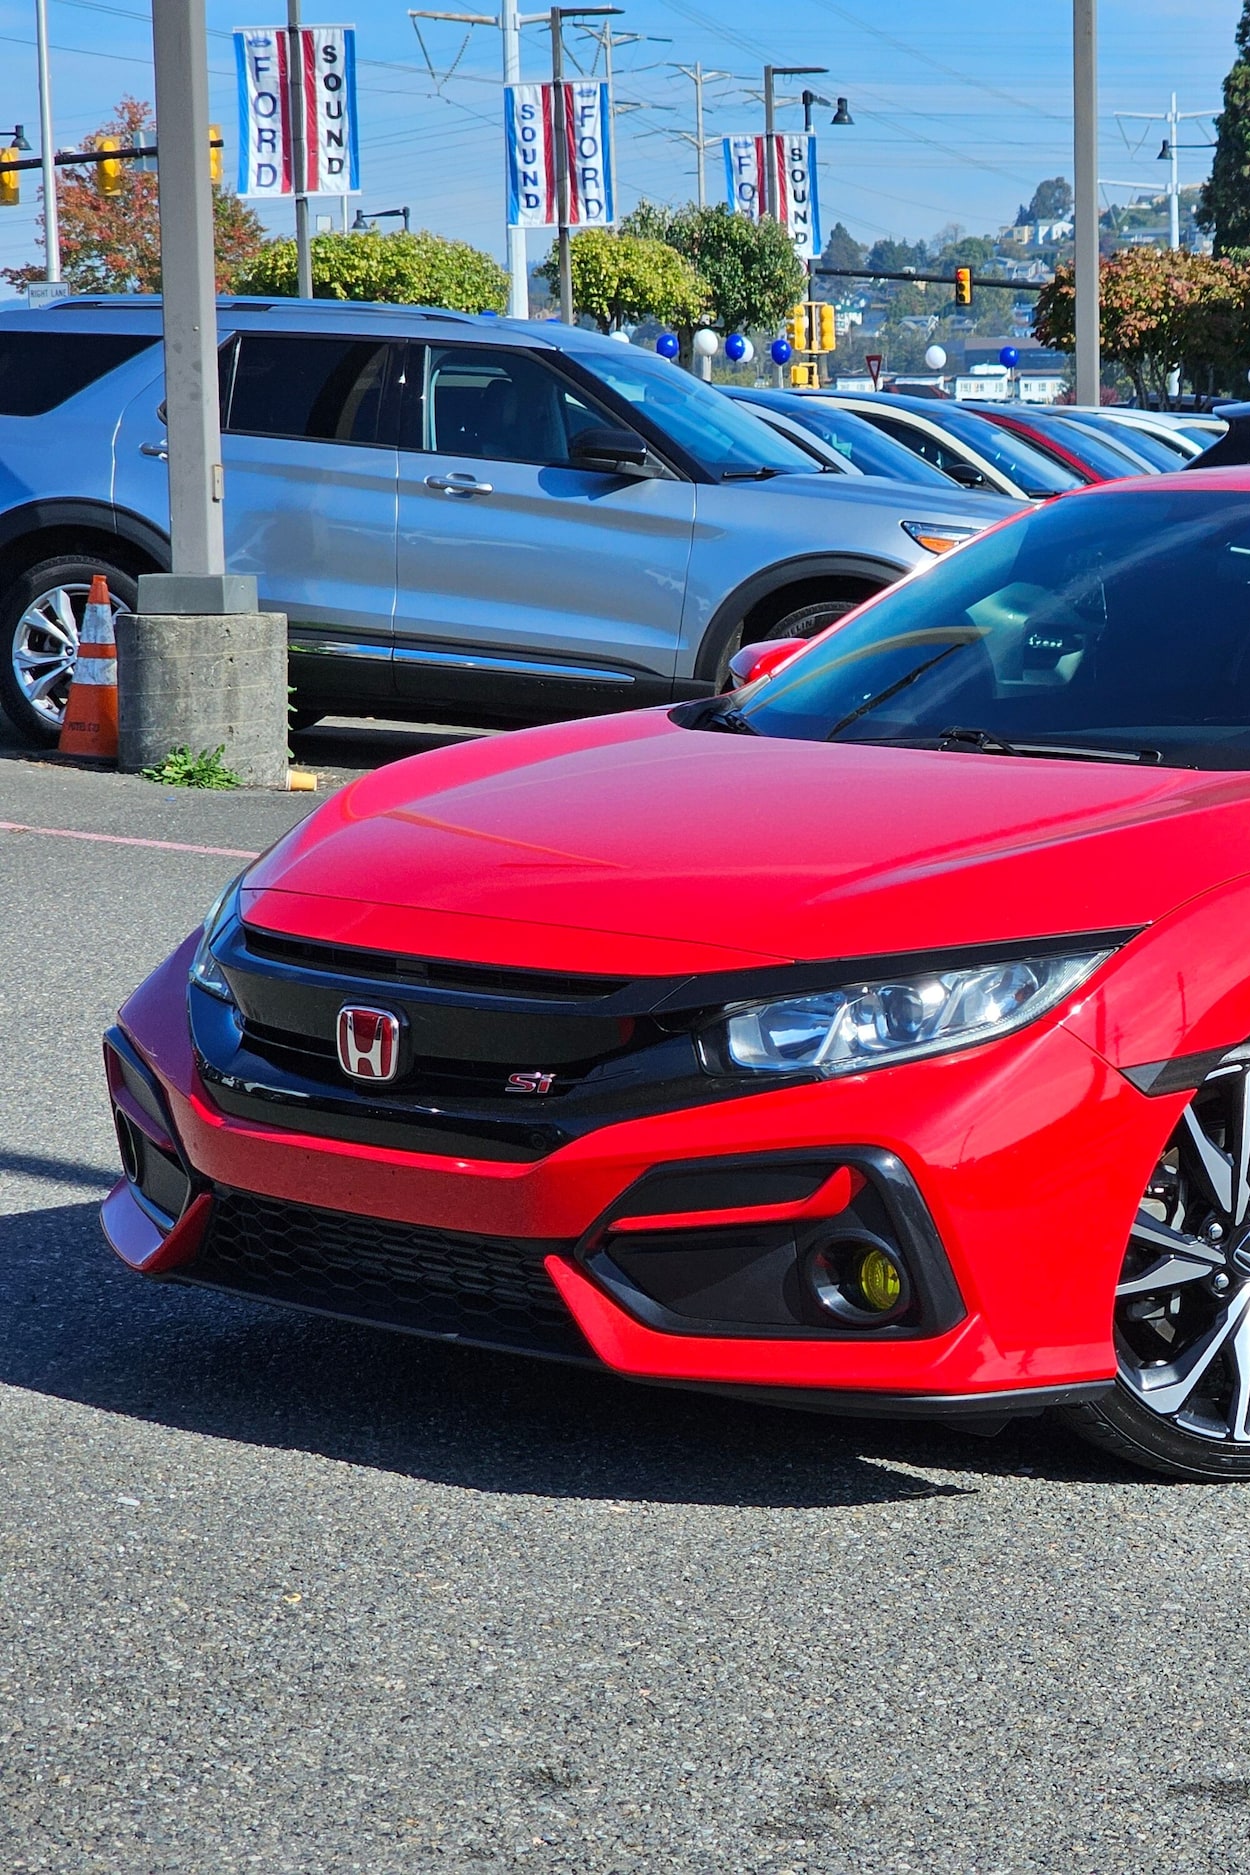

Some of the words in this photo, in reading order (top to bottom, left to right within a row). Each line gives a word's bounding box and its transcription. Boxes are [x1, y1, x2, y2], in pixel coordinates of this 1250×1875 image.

[254, 56, 277, 188] FORD
[322, 45, 344, 175] SOUND
[521, 104, 540, 209] SOUND
[579, 105, 603, 219] FORD
[790, 147, 808, 245] SOUND
[504, 1071, 557, 1094] Si
